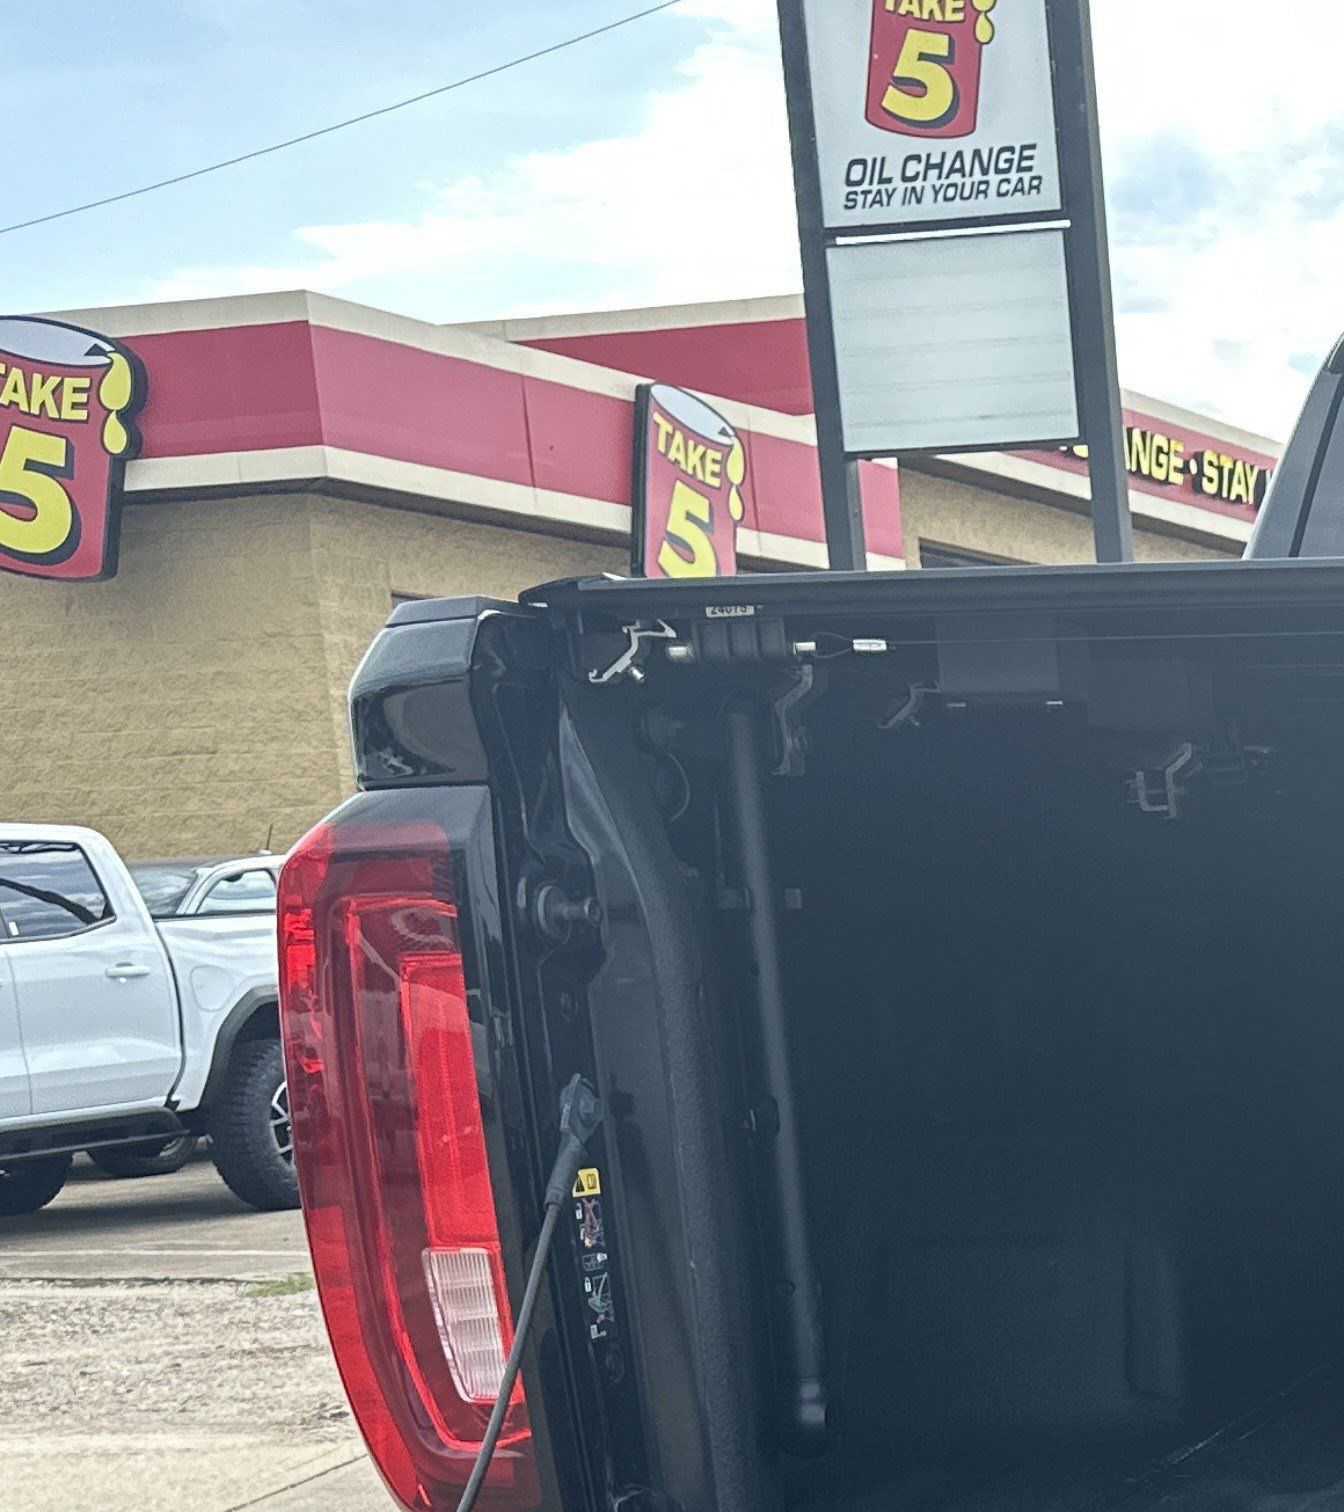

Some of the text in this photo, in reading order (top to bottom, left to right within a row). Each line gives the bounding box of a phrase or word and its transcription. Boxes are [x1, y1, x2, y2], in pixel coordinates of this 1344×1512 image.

[881, 27, 957, 123] 5
[843, 174, 1043, 210] STAY IN YOUR CAR
[844, 143, 1038, 188] OIL CHANGE
[0, 361, 91, 422] AKE
[652, 411, 724, 489] TAKE
[1202, 449, 1260, 505] STAY
[0, 425, 73, 555] 5
[657, 479, 718, 578] 5
